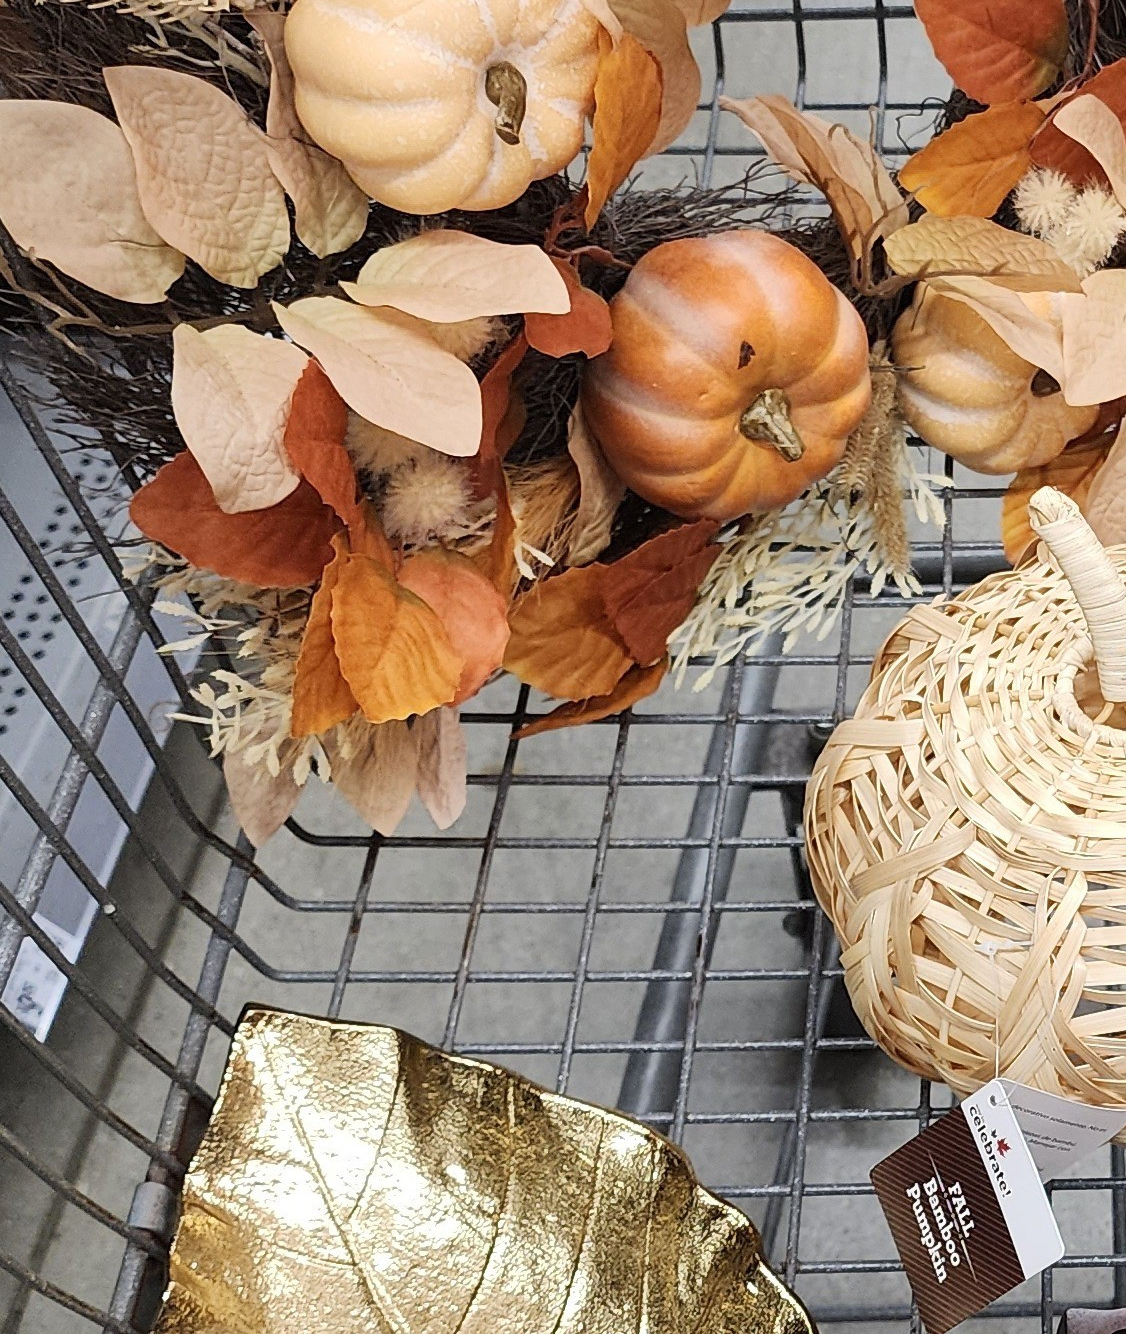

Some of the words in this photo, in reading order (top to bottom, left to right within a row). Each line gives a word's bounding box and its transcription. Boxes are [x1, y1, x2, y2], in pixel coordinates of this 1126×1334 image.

[969, 1105, 1012, 1198] celebrate!
[905, 1182, 948, 1284] Pumpkin
[923, 1177, 961, 1267] Bamboo
[948, 1181, 976, 1239] FALL
